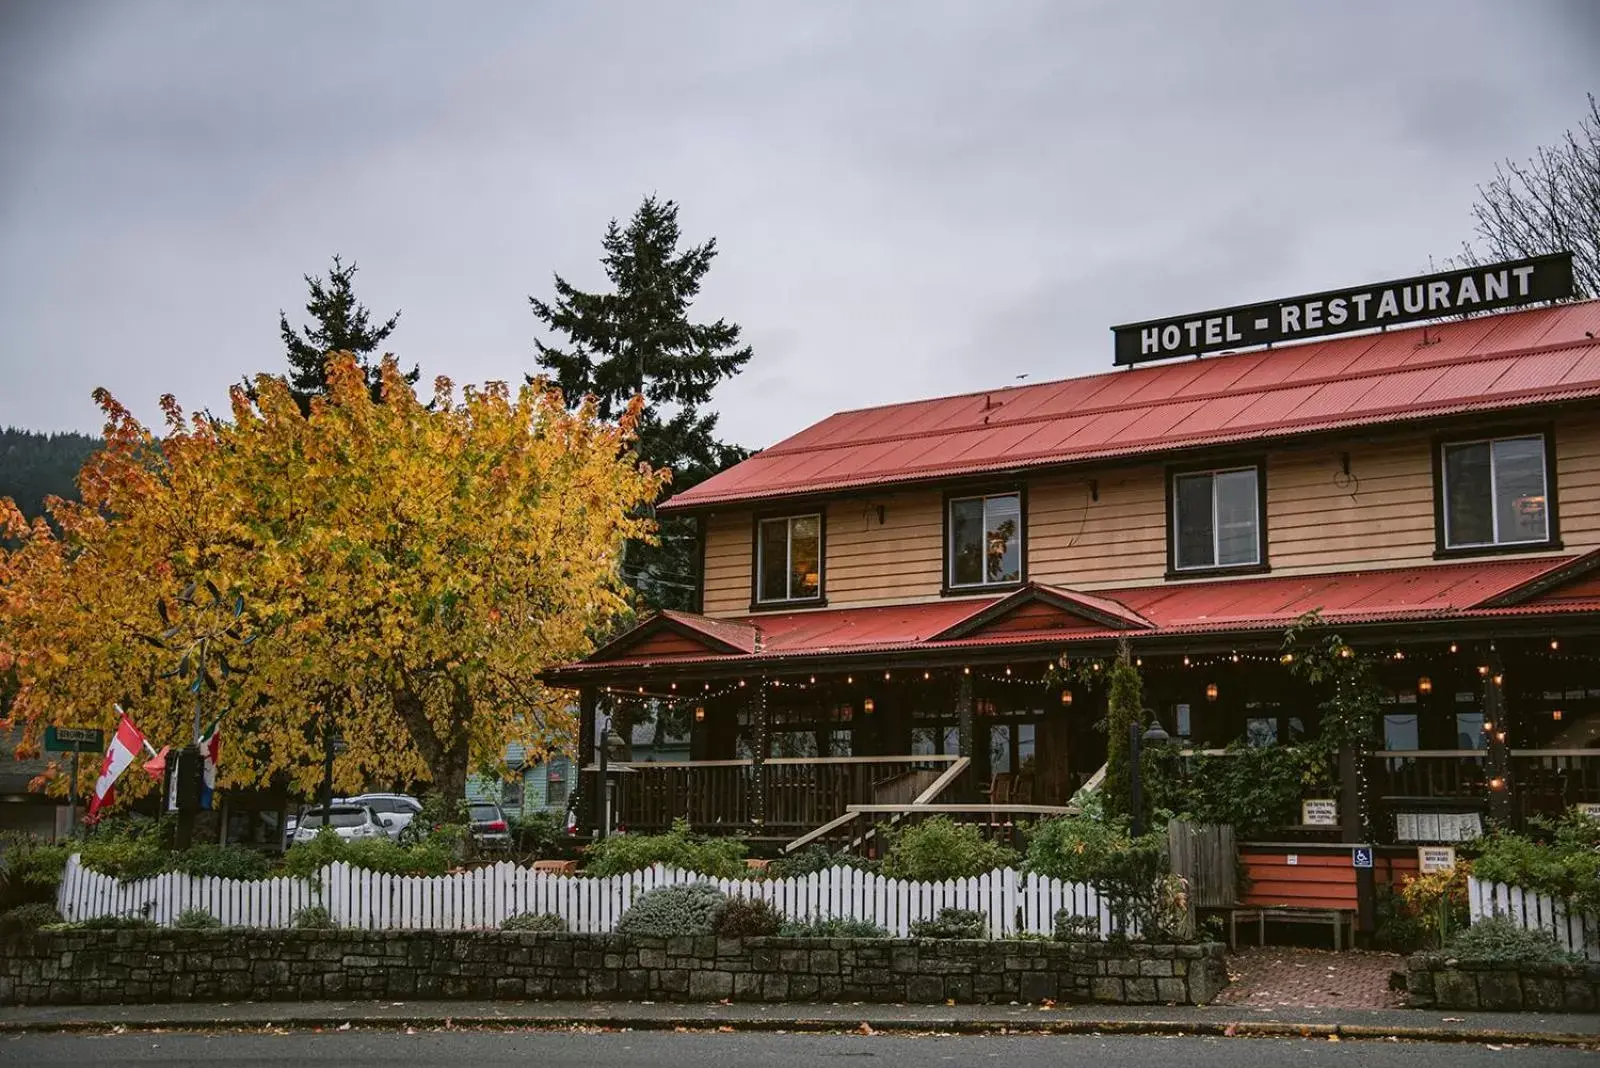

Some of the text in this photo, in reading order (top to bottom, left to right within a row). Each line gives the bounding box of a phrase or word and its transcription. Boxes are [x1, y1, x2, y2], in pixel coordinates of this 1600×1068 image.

[1141, 266, 1535, 354] HOTEL - RESTAURANT
